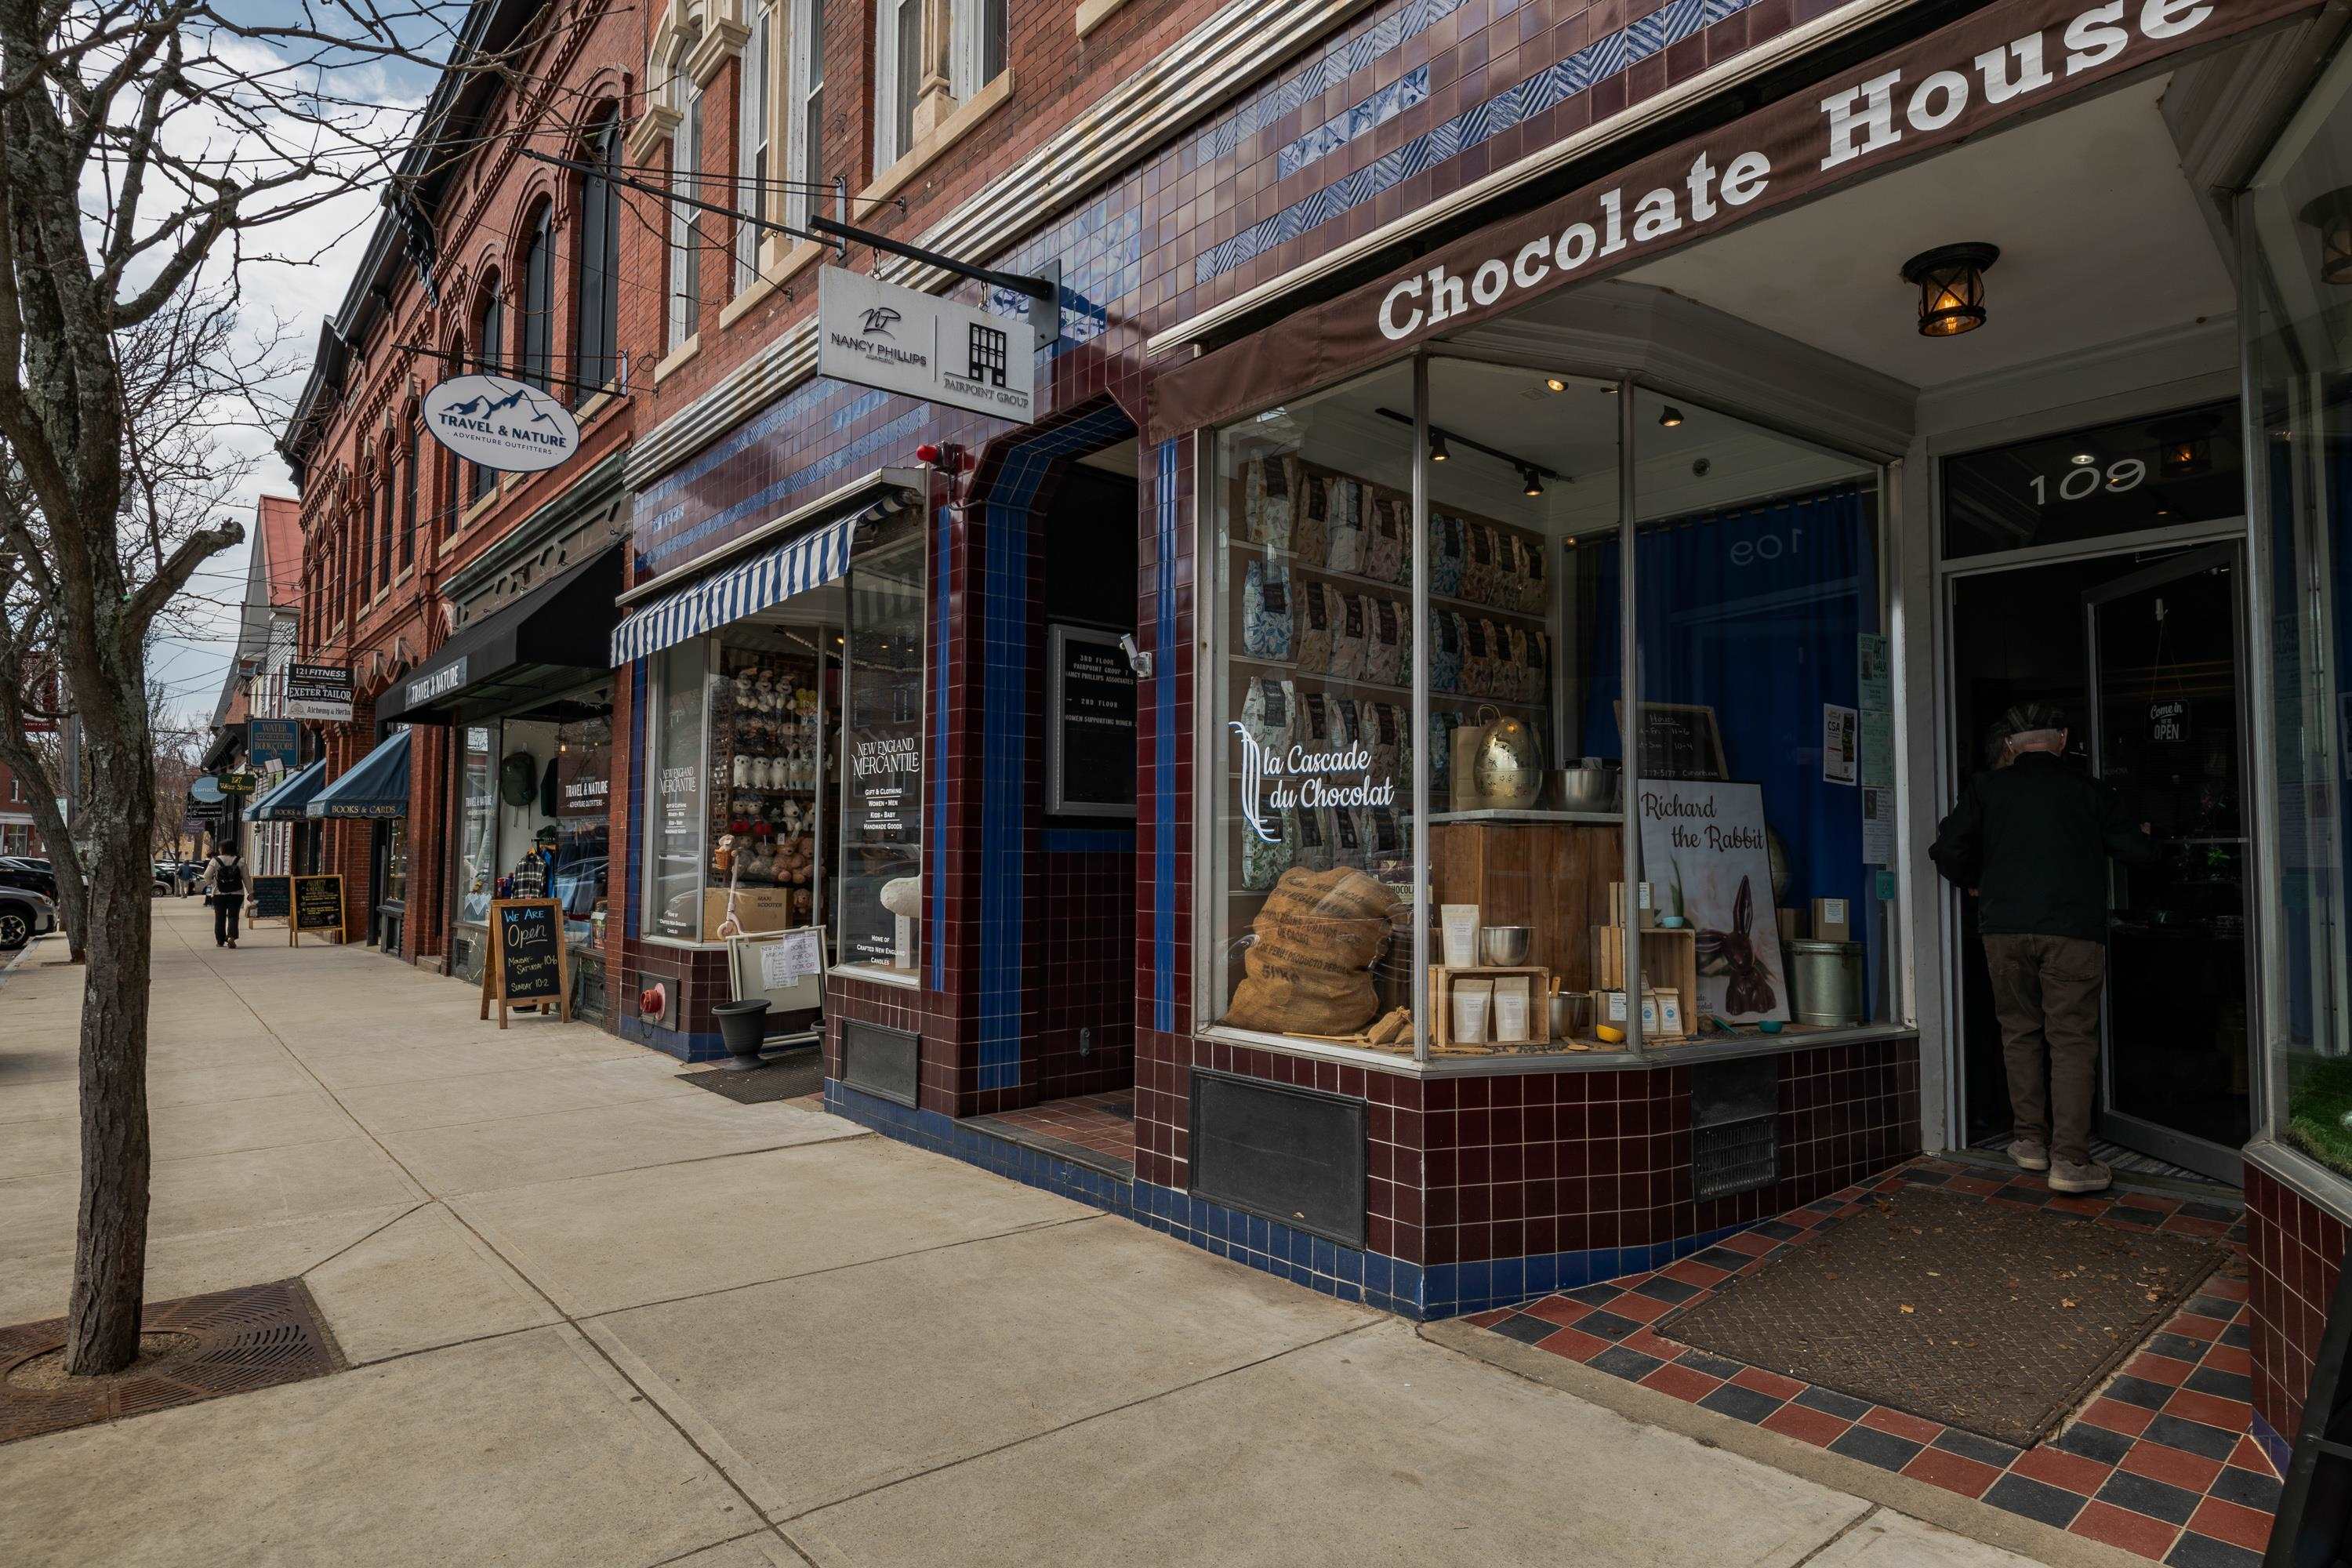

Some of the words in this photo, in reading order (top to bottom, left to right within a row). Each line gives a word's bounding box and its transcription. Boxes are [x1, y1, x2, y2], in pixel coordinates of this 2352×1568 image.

[1378, 151, 1771, 340] Chocolate
[1820, 0, 2215, 171] House
[831, 332, 874, 352] NANCY
[877, 345, 927, 366] PHILLIPS
[944, 378, 994, 399] PAIRPOINT
[996, 392, 1029, 408] GROUP
[438, 413, 494, 434] TRAVEL
[498, 425, 508, 437] &
[512, 428, 567, 448] NATURE
[453, 432, 502, 445] ADVENTURE
[505, 441, 552, 455] OUTFITTERS
[2030, 459, 2146, 505] 109
[1073, 662, 1102, 672] PAIRPOINT
[1096, 657, 1114, 666] FLOOR
[296, 667, 307, 676] 121
[309, 669, 347, 678] FITNESS
[412, 680, 430, 704] TRAVEL
[430, 676, 436, 696] &
[436, 665, 459, 695] NATURE
[289, 688, 321, 698] EXETER
[322, 689, 352, 702] TAILOR
[1084, 716, 1114, 725] SUPPORTING
[1116, 719, 1132, 728] WOMEN
[2151, 705, 2173, 720] Come
[1828, 720, 1841, 733] CSA
[2154, 724, 2180, 740] OPEN
[857, 742, 877, 757] NEW
[877, 737, 914, 756] ENGLAND
[1263, 746, 1283, 775] la
[1287, 739, 1371, 774] Cascade
[851, 752, 920, 779] MERCANTILE
[565, 785, 583, 798] TRAVEL
[583, 784, 588, 796] &
[588, 781, 608, 795] NATURE
[659, 777, 696, 797] MERCANTILE
[1270, 779, 1297, 808] du
[1301, 775, 1395, 808] Chocolat
[332, 805, 358, 814] BOOKS
[369, 805, 396, 814] CARDS
[1641, 792, 1717, 820] Richard
[1671, 825, 1701, 848] the
[1704, 824, 1764, 852] Rabbit
[504, 910, 519, 922] WE
[524, 909, 545, 920] ARE
[508, 924, 546, 949] Open
[857, 944, 874, 953] CRAFTED
[511, 982, 532, 992] SUNDAY
[535, 978, 549, 988] 10-2
